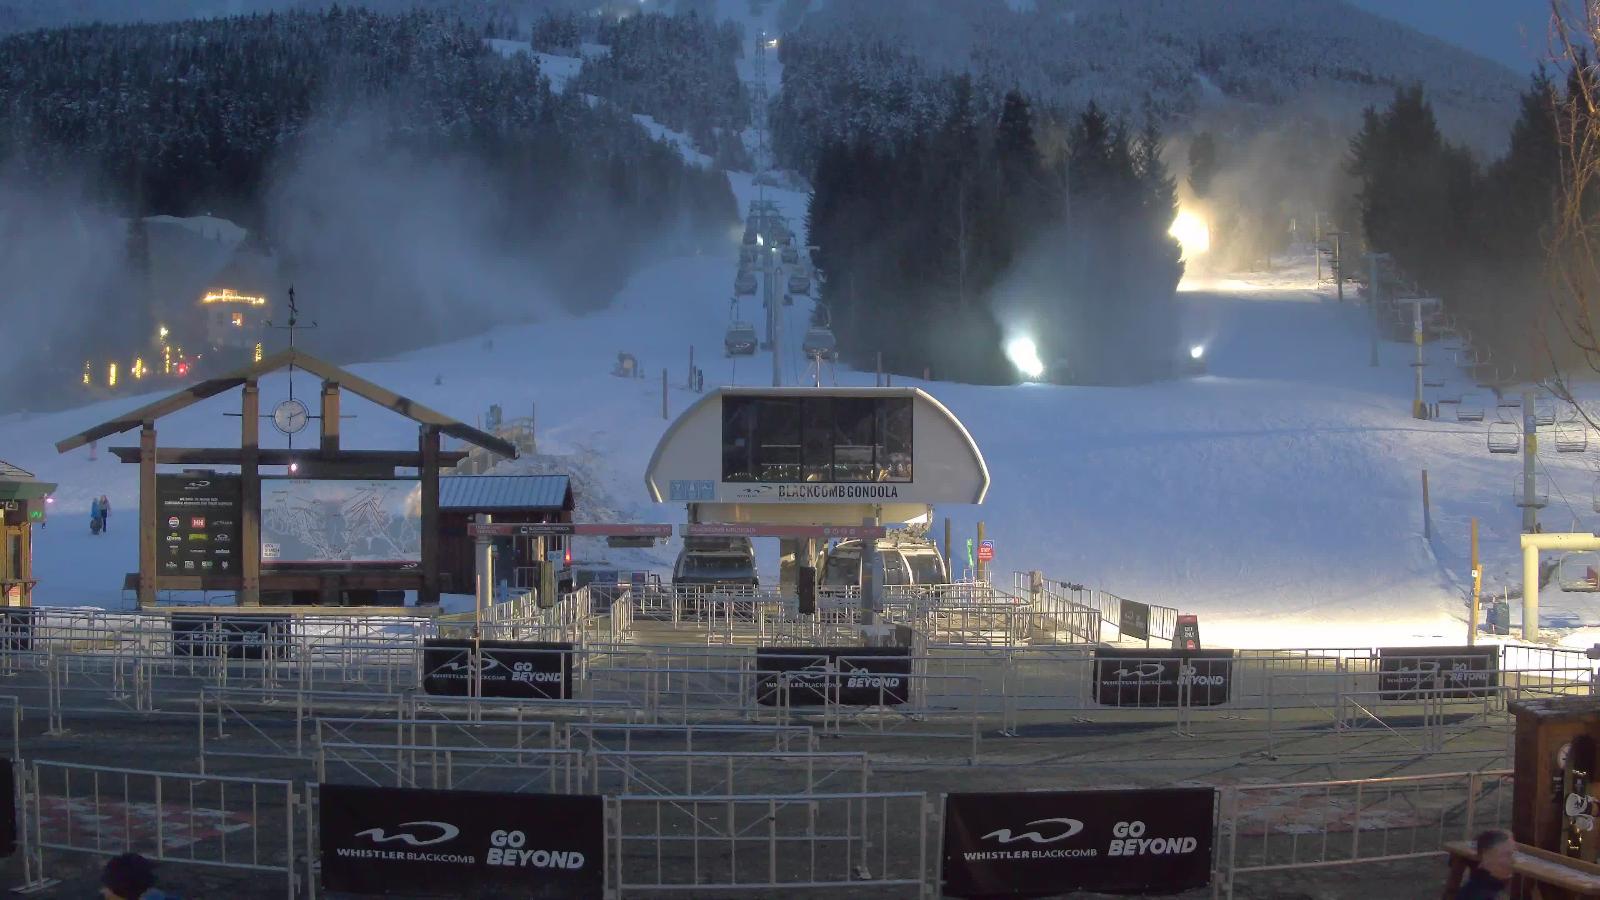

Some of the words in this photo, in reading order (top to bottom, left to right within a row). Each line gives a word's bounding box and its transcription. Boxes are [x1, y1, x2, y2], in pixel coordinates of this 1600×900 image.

[513, 661, 533, 671] GO
[511, 671, 562, 682] BEYOND
[847, 677, 900, 688] BEYOND
[1112, 821, 1146, 838] GO
[490, 830, 526, 847] GO
[1107, 837, 1198, 856] BEYOND
[337, 848, 405, 861] WHISTLER
[406, 852, 475, 864] BLACKCOMB
[486, 848, 585, 869] BEYOND
[963, 849, 1030, 861] WHISTLER
[1031, 848, 1098, 859] BLACKCOMB
